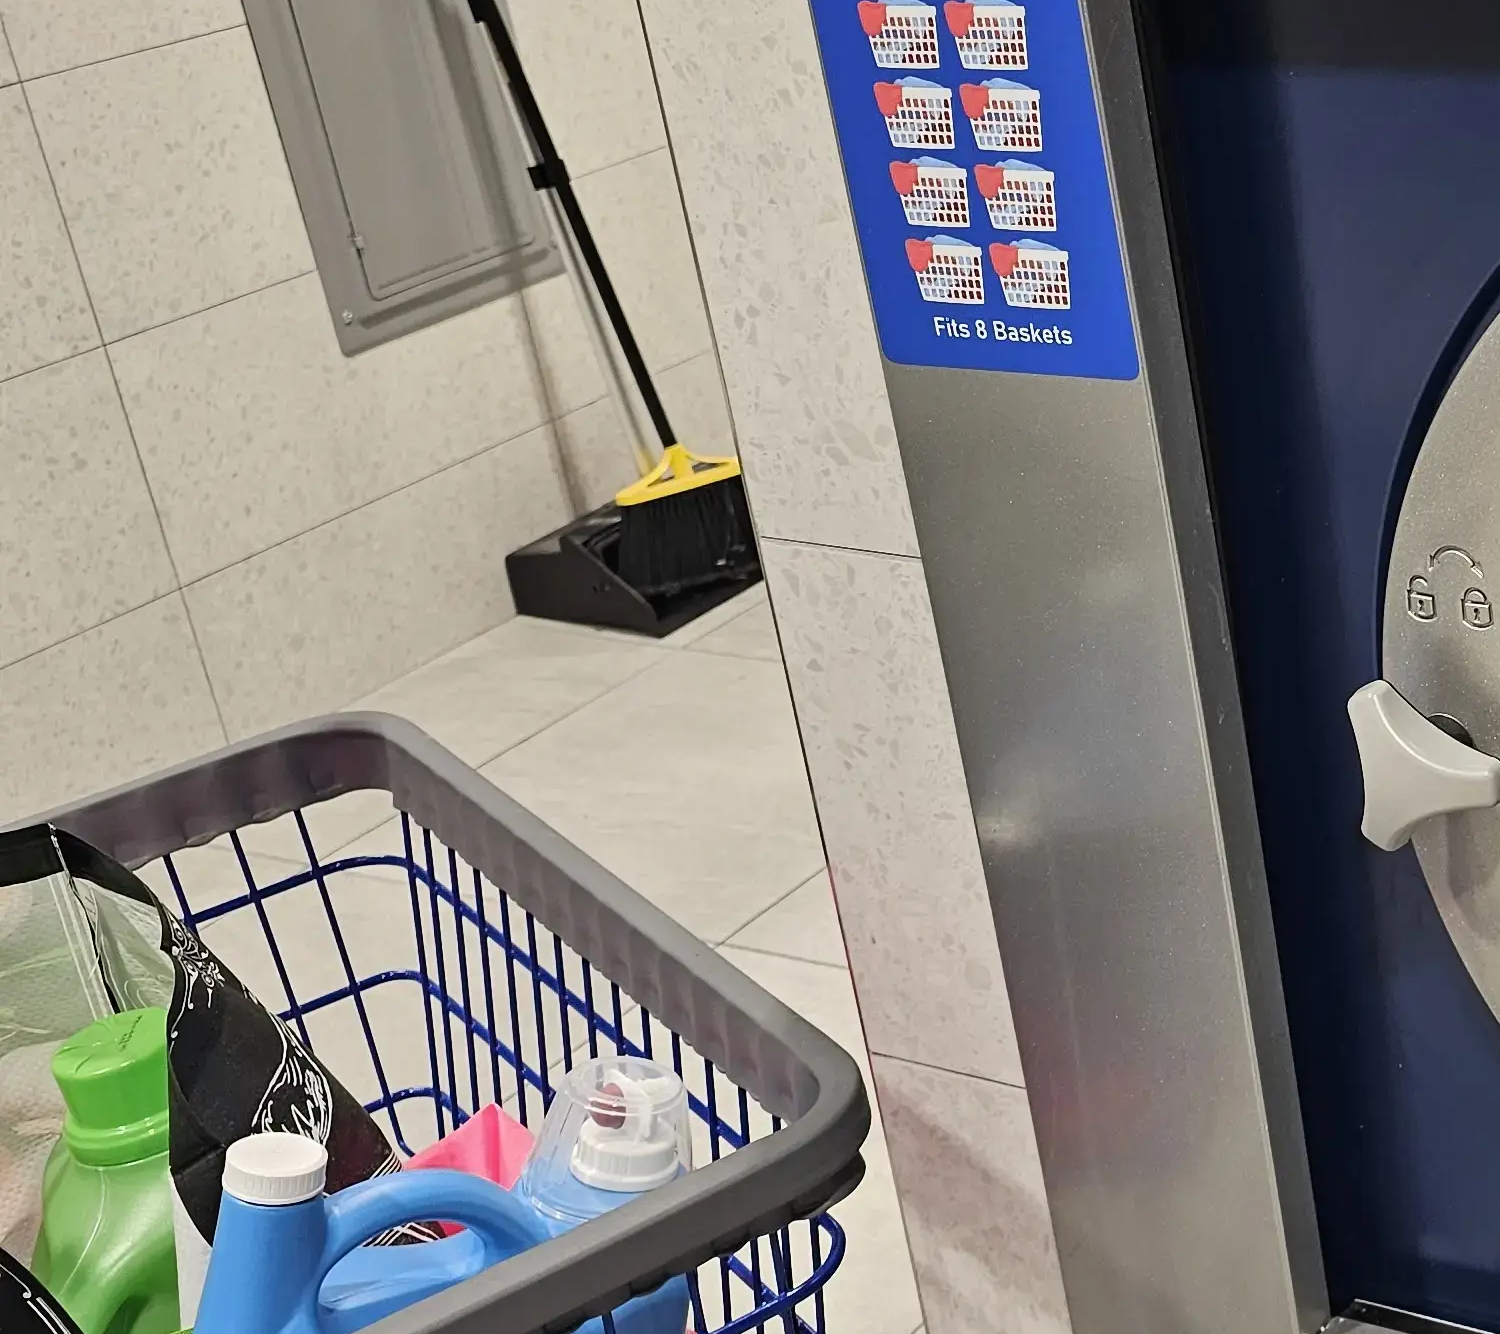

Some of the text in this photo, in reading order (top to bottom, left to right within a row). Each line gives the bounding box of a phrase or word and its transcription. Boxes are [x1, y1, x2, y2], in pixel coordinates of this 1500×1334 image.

[933, 316, 1073, 345] Fits 8 Baskets
